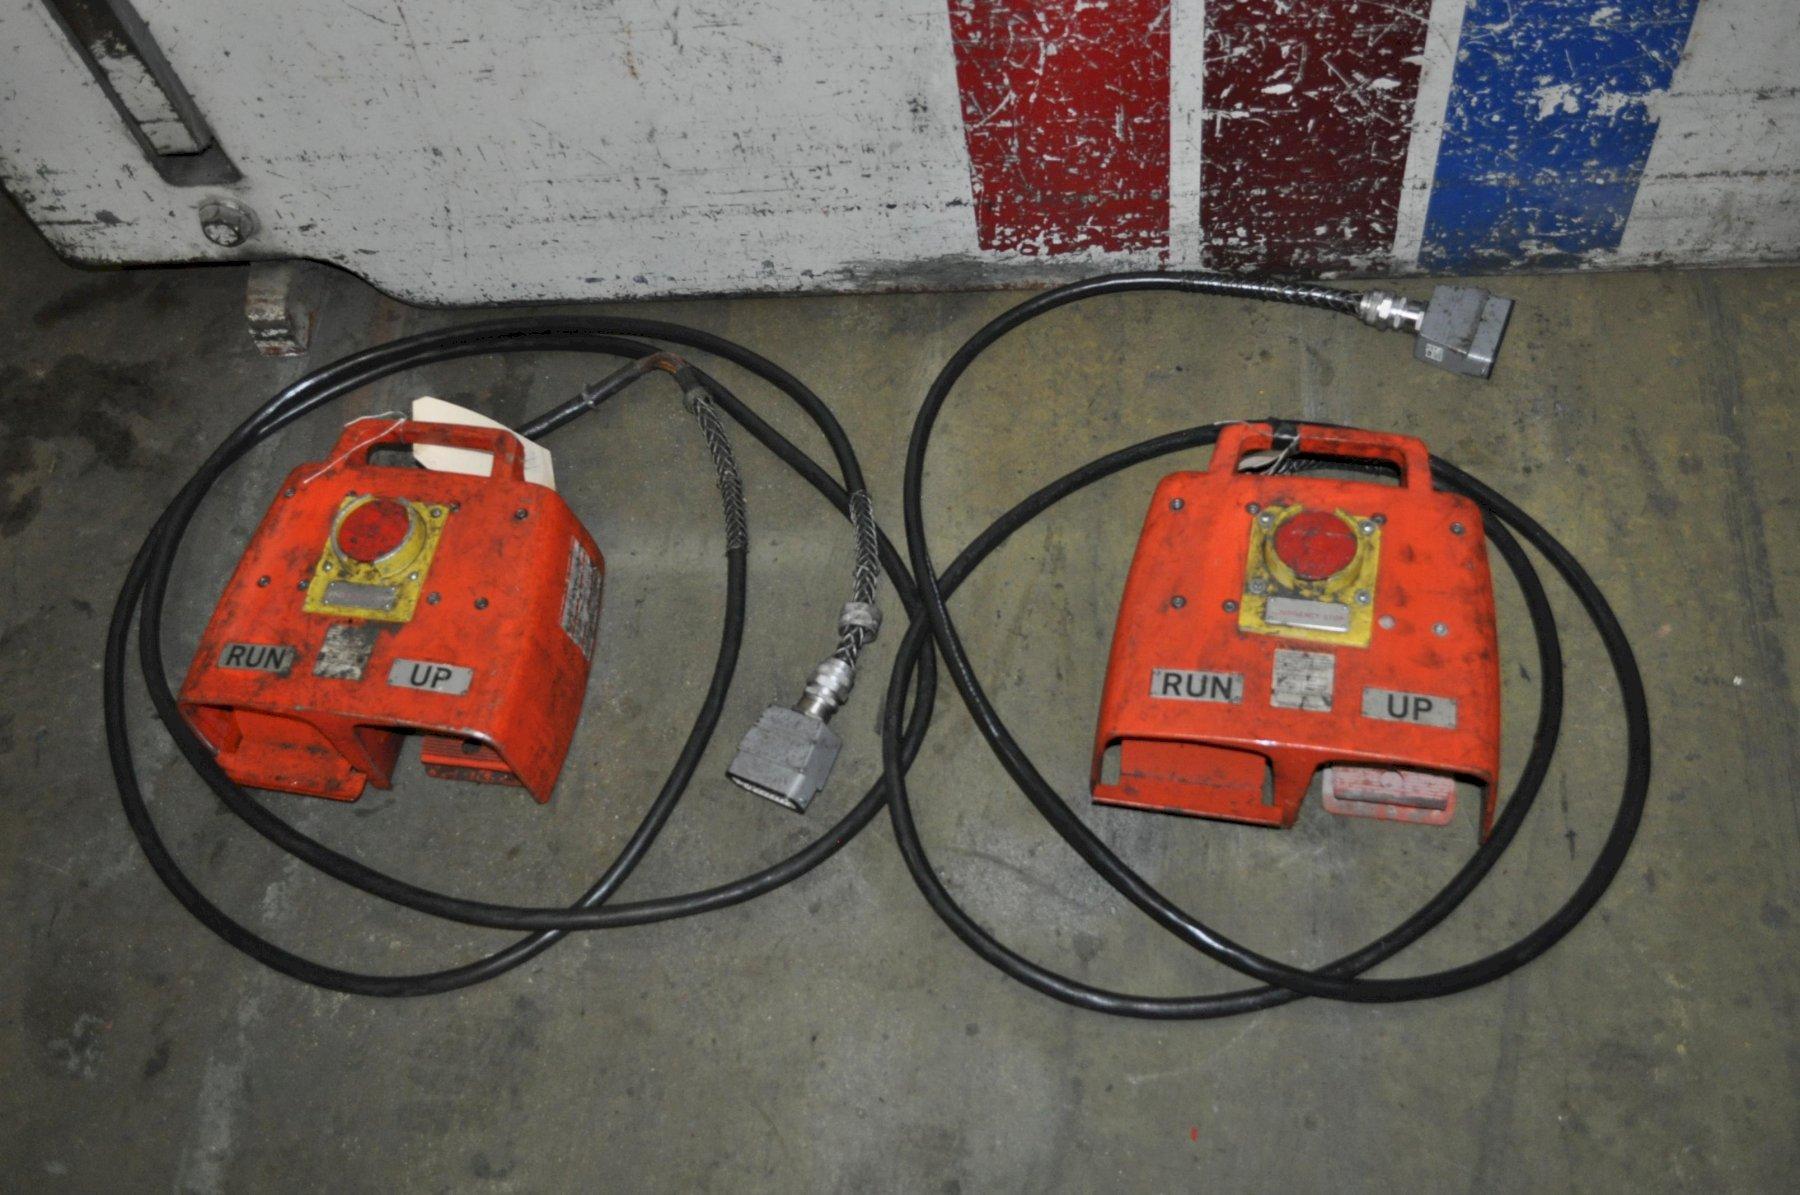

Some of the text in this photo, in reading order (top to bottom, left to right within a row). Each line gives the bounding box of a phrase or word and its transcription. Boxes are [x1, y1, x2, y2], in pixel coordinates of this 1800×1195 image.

[226, 645, 286, 669] RUN
[410, 663, 452, 688] UP
[1162, 672, 1232, 699] RUN
[1388, 693, 1432, 720] UP
